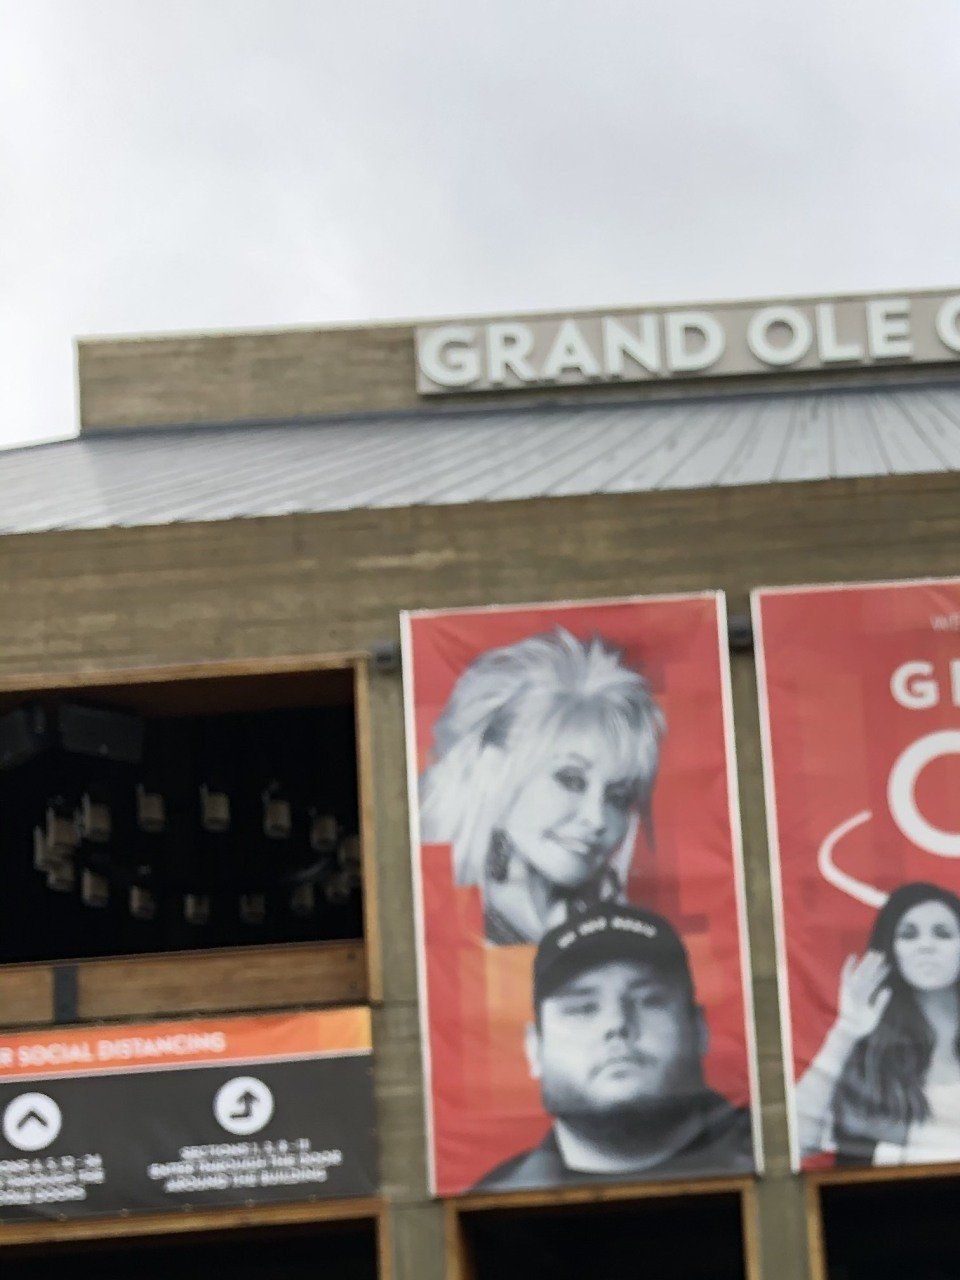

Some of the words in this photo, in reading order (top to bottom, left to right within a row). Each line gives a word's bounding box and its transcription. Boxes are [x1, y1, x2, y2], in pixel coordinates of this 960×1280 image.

[418, 310, 725, 388] GRAND
[747, 299, 914, 367] OLE
[18, 1042, 93, 1067] SOCIAL
[98, 1031, 226, 1060] DISTANCING
